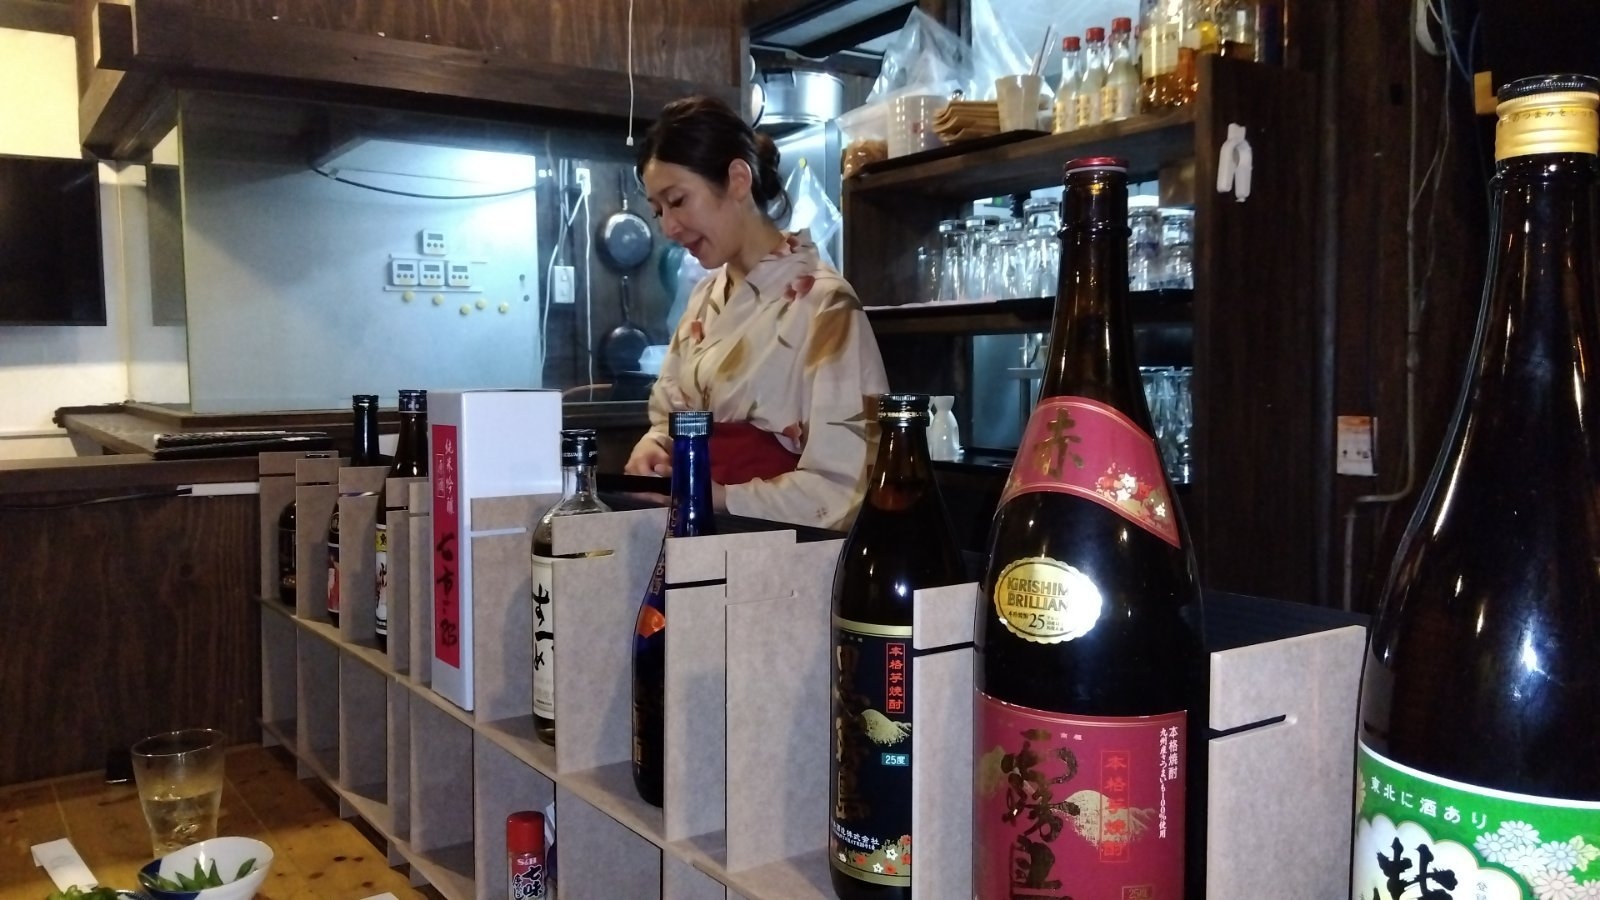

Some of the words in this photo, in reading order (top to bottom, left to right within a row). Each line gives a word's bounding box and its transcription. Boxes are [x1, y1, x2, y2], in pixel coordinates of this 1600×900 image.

[1033, 407, 1085, 480] 赤
[1007, 576, 1069, 596] KIRISHIM
[1007, 592, 1068, 612] BRILLIAN
[1028, 613, 1046, 630] 25
[888, 645, 904, 710] 本格芋焼酎
[884, 754, 907, 766] 25度
[1168, 725, 1179, 780] 本格焼酎
[1370, 776, 1487, 830] 東北に酒あり
